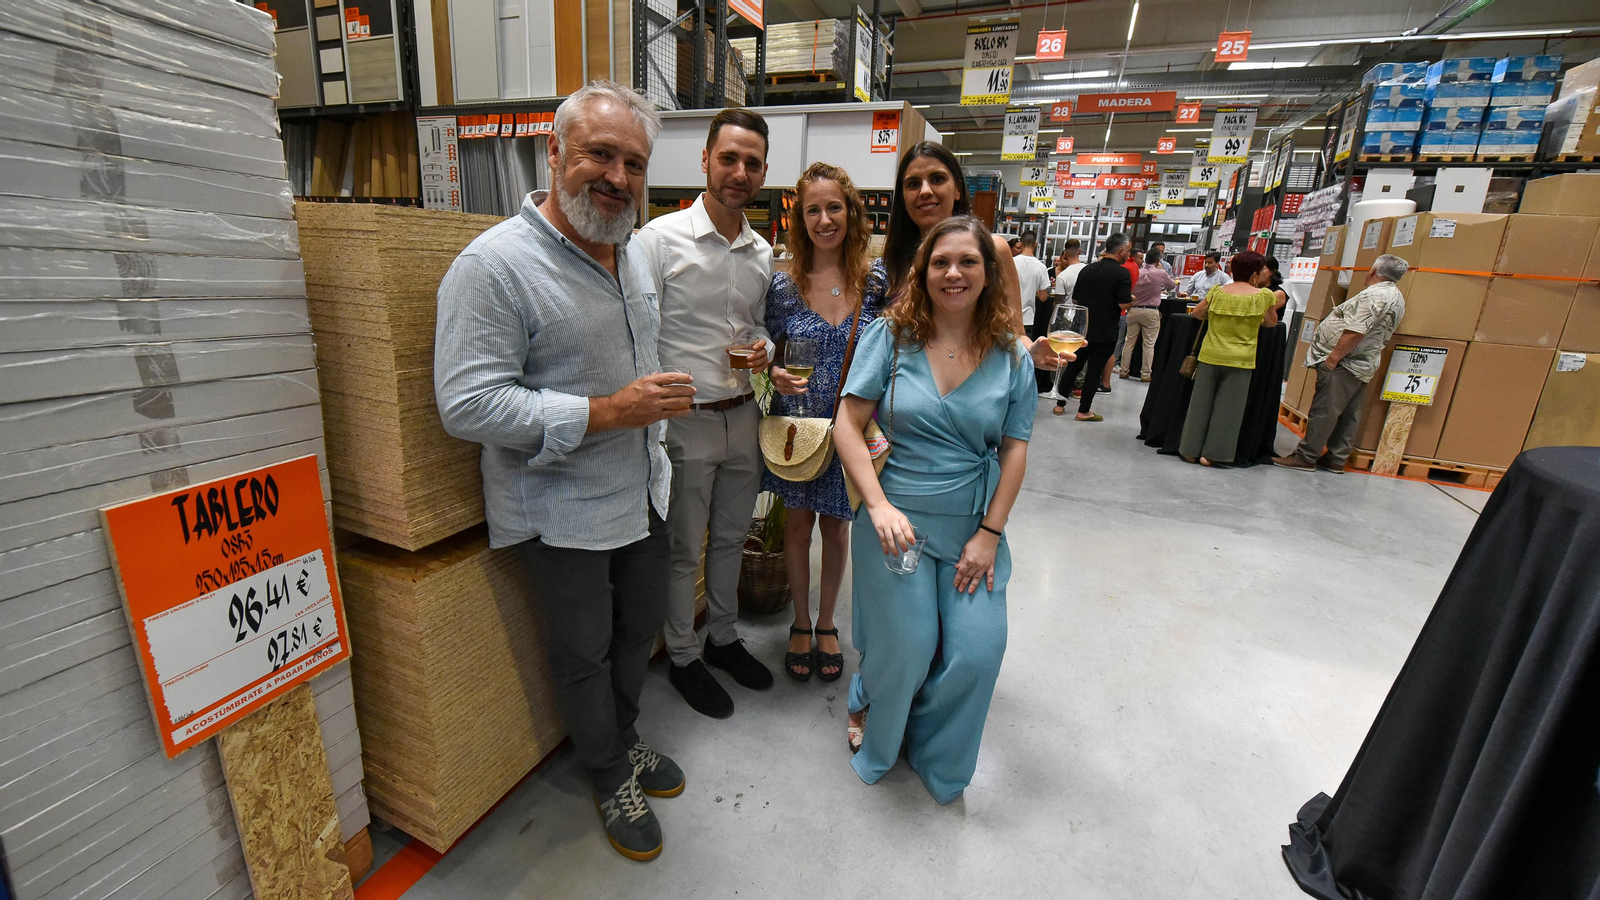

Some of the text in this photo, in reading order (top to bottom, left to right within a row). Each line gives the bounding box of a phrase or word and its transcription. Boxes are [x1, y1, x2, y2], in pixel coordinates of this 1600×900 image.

[974, 36, 996, 51] SUELO
[1040, 38, 1062, 53] 26
[1219, 40, 1246, 55] 25
[1098, 97, 1152, 107] MADERA
[1053, 106, 1069, 117] 28
[1179, 108, 1197, 119] 27
[1223, 115, 1238, 125] PACK
[1058, 141, 1071, 150] 30
[1159, 142, 1174, 151] 29
[1224, 138, 1241, 156] 99
[1143, 164, 1153, 172] 31
[1200, 167, 1213, 181] 95
[1104, 178, 1118, 186] EN
[1403, 374, 1422, 393] 75
[171, 473, 279, 545] TABLERO
[221, 529, 253, 559] OSB3
[148, 611, 170, 622] PRECIO
[170, 601, 195, 614] UNITARIO
[200, 592, 216, 602] PALET
[228, 568, 311, 643] 26.41 €
[294, 594, 330, 618] IVA INCLUIDO
[267, 616, 324, 673] 27.81 €
[164, 663, 209, 688] PRECIO UNITARIO
[265, 682, 273, 690] A
[273, 664, 304, 685] PAGAR
[304, 647, 334, 668] MENOS
